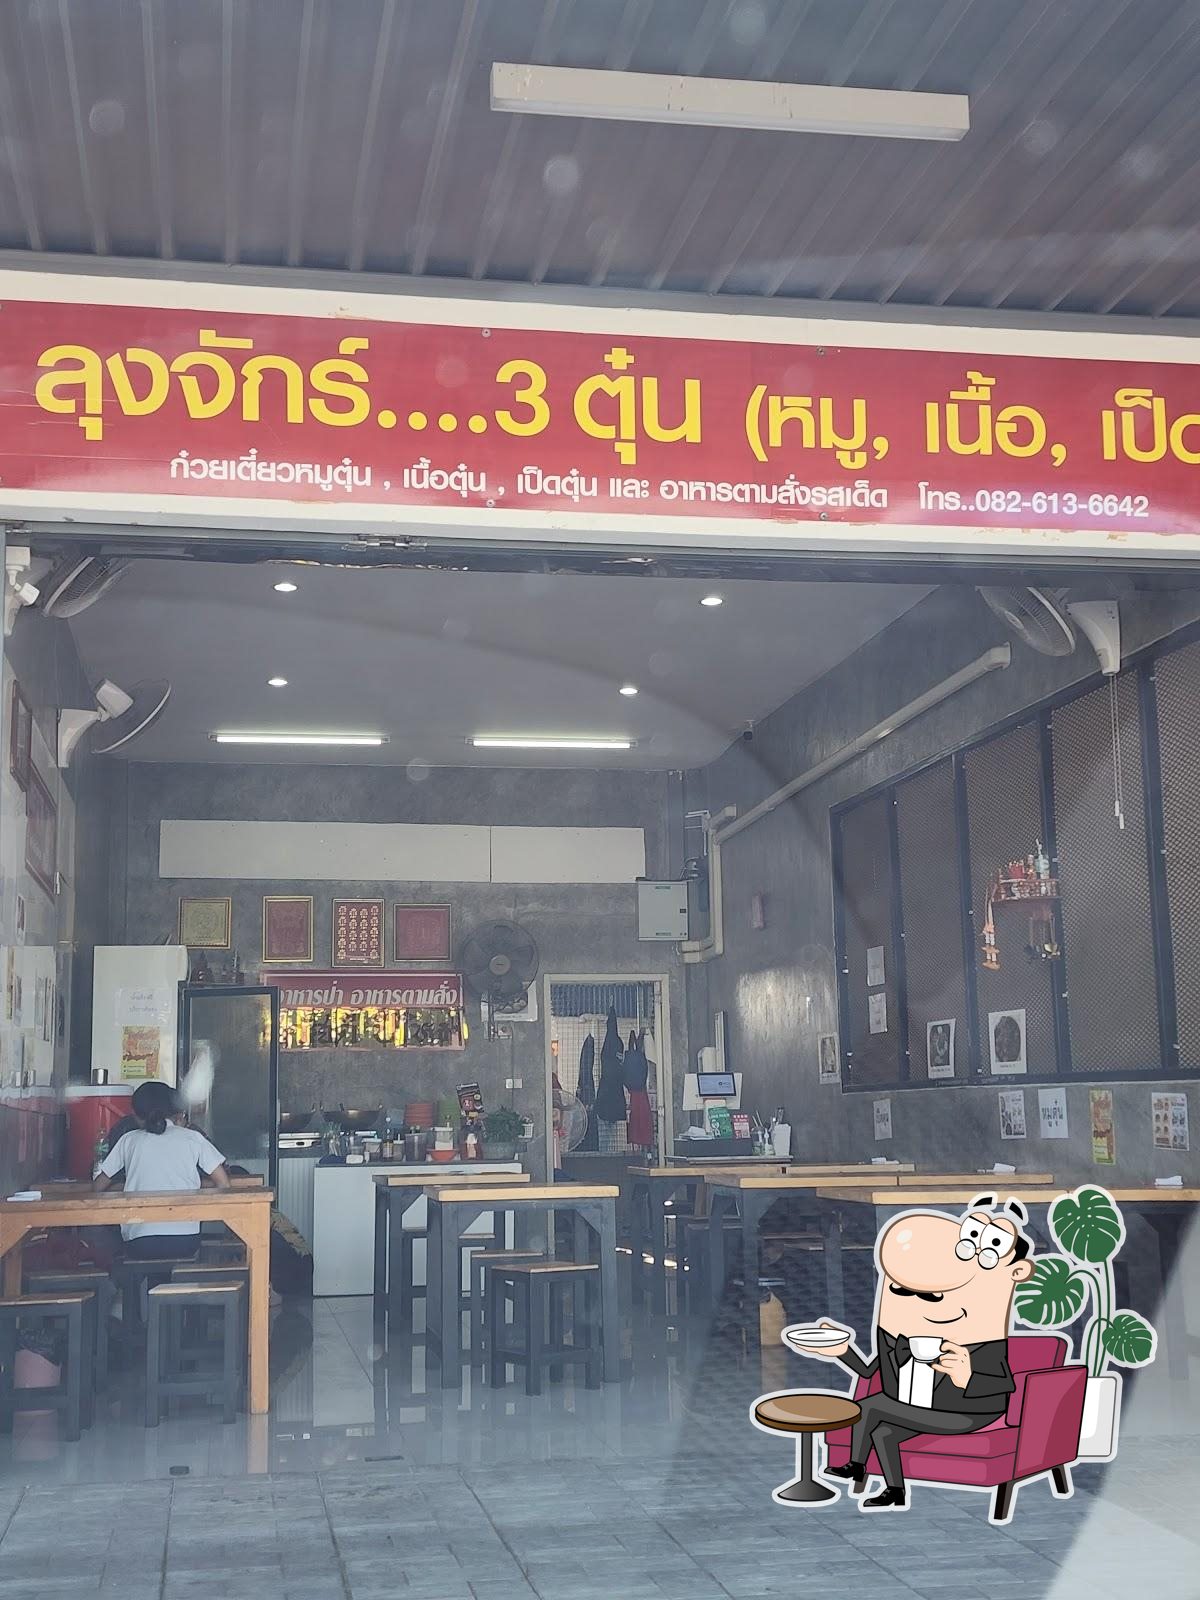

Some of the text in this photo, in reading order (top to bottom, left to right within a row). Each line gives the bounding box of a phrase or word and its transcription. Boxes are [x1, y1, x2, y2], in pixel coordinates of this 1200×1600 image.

[573, 347, 702, 466] ตุ๋น
[925, 371, 1067, 468] เนื้อ,
[170, 447, 373, 493] ก๋วยเตี๋ยวหมูตุ๋น
[403, 456, 487, 498] เนื้อตุ๋น
[517, 465, 598, 503] เป็ดตุ๋น
[609, 477, 650, 499] และ
[659, 473, 888, 508] อาหารตามสั่งรสเด็ด
